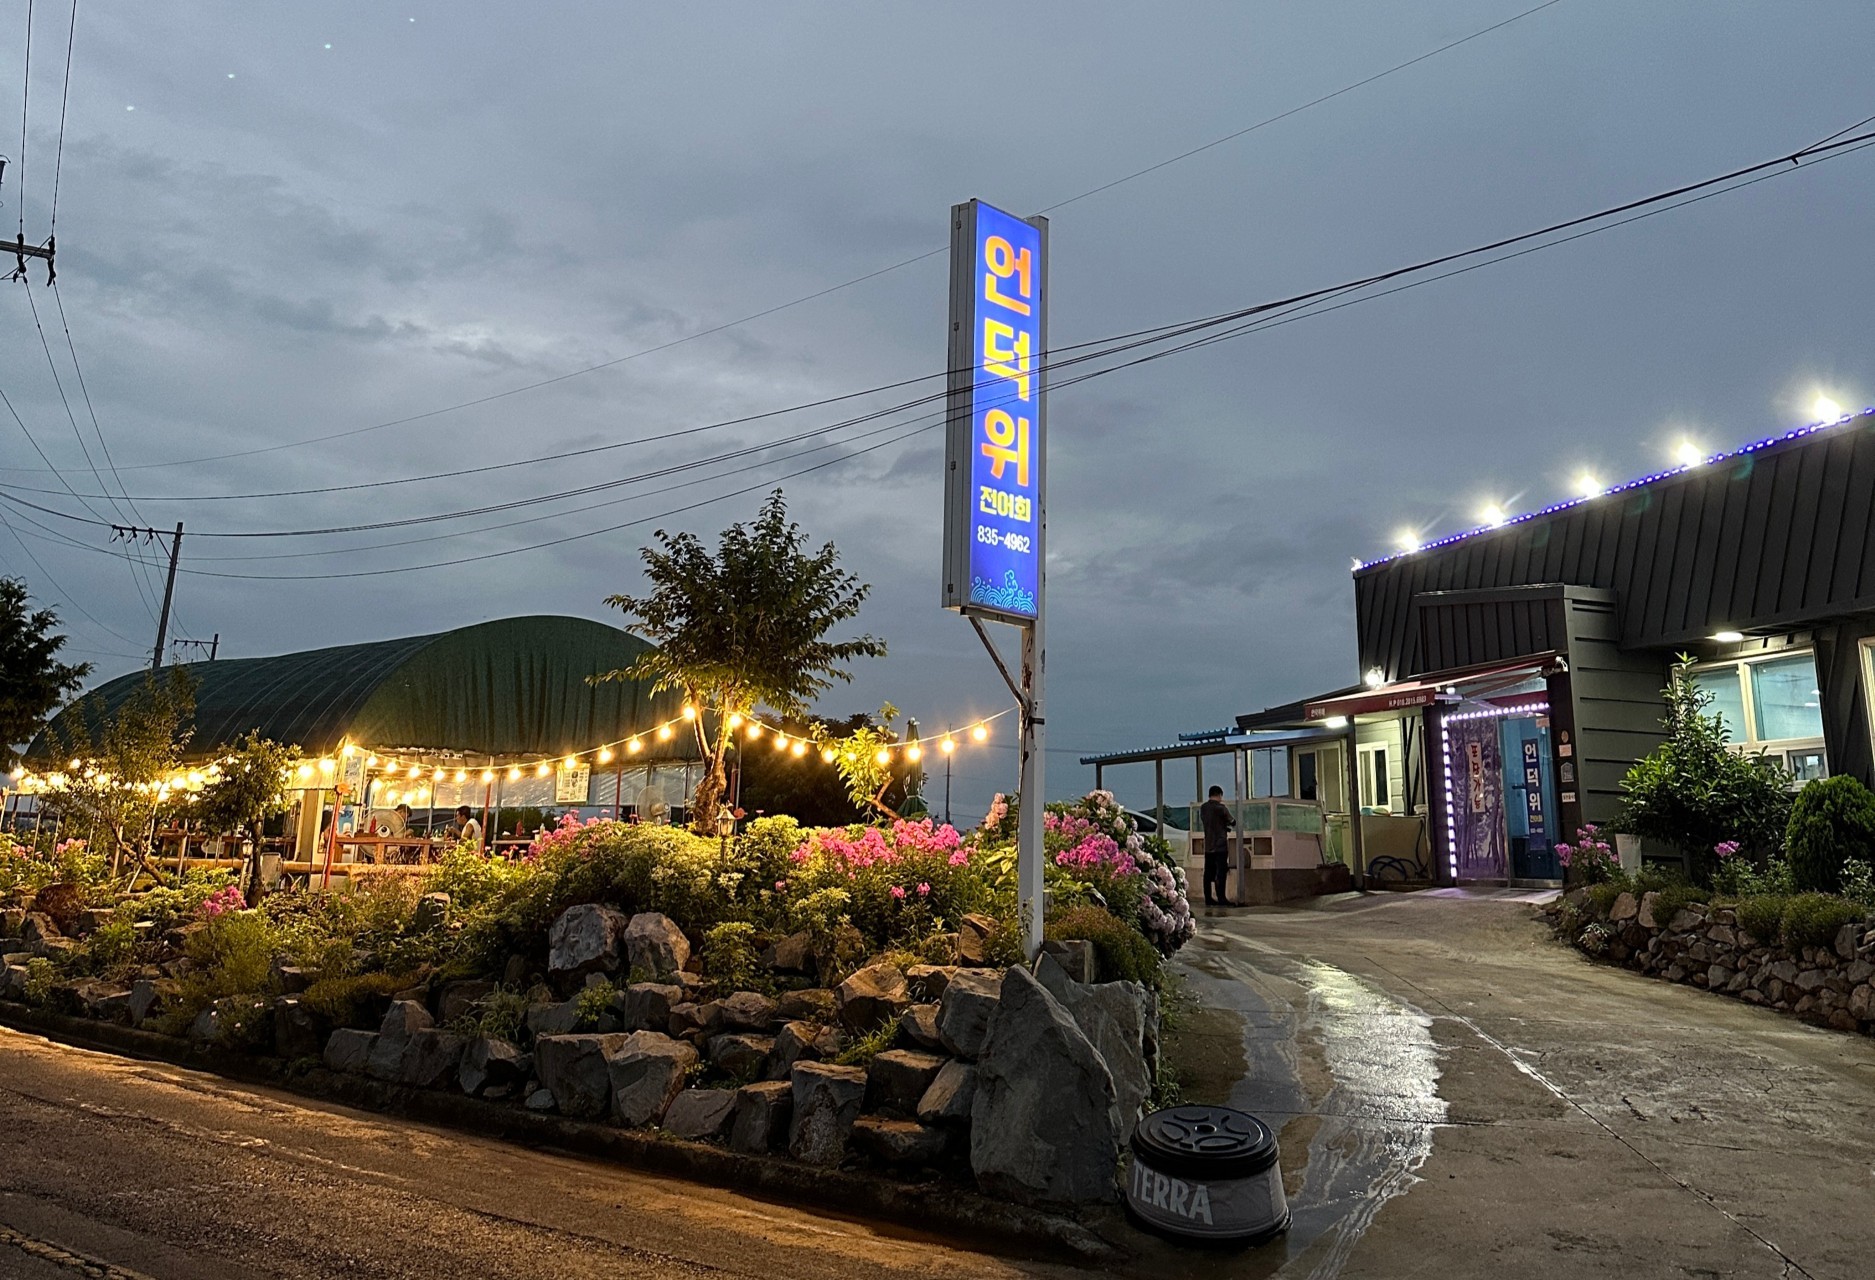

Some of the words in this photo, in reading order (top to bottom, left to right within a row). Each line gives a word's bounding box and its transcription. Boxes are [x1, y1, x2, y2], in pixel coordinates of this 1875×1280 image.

[981, 235, 1031, 487] 언덕위
[979, 486, 1031, 523] 전어회
[977, 525, 1031, 554] 835-4962
[1525, 743, 1541, 811] 언덕위
[1132, 1158, 1214, 1226] TERRA
